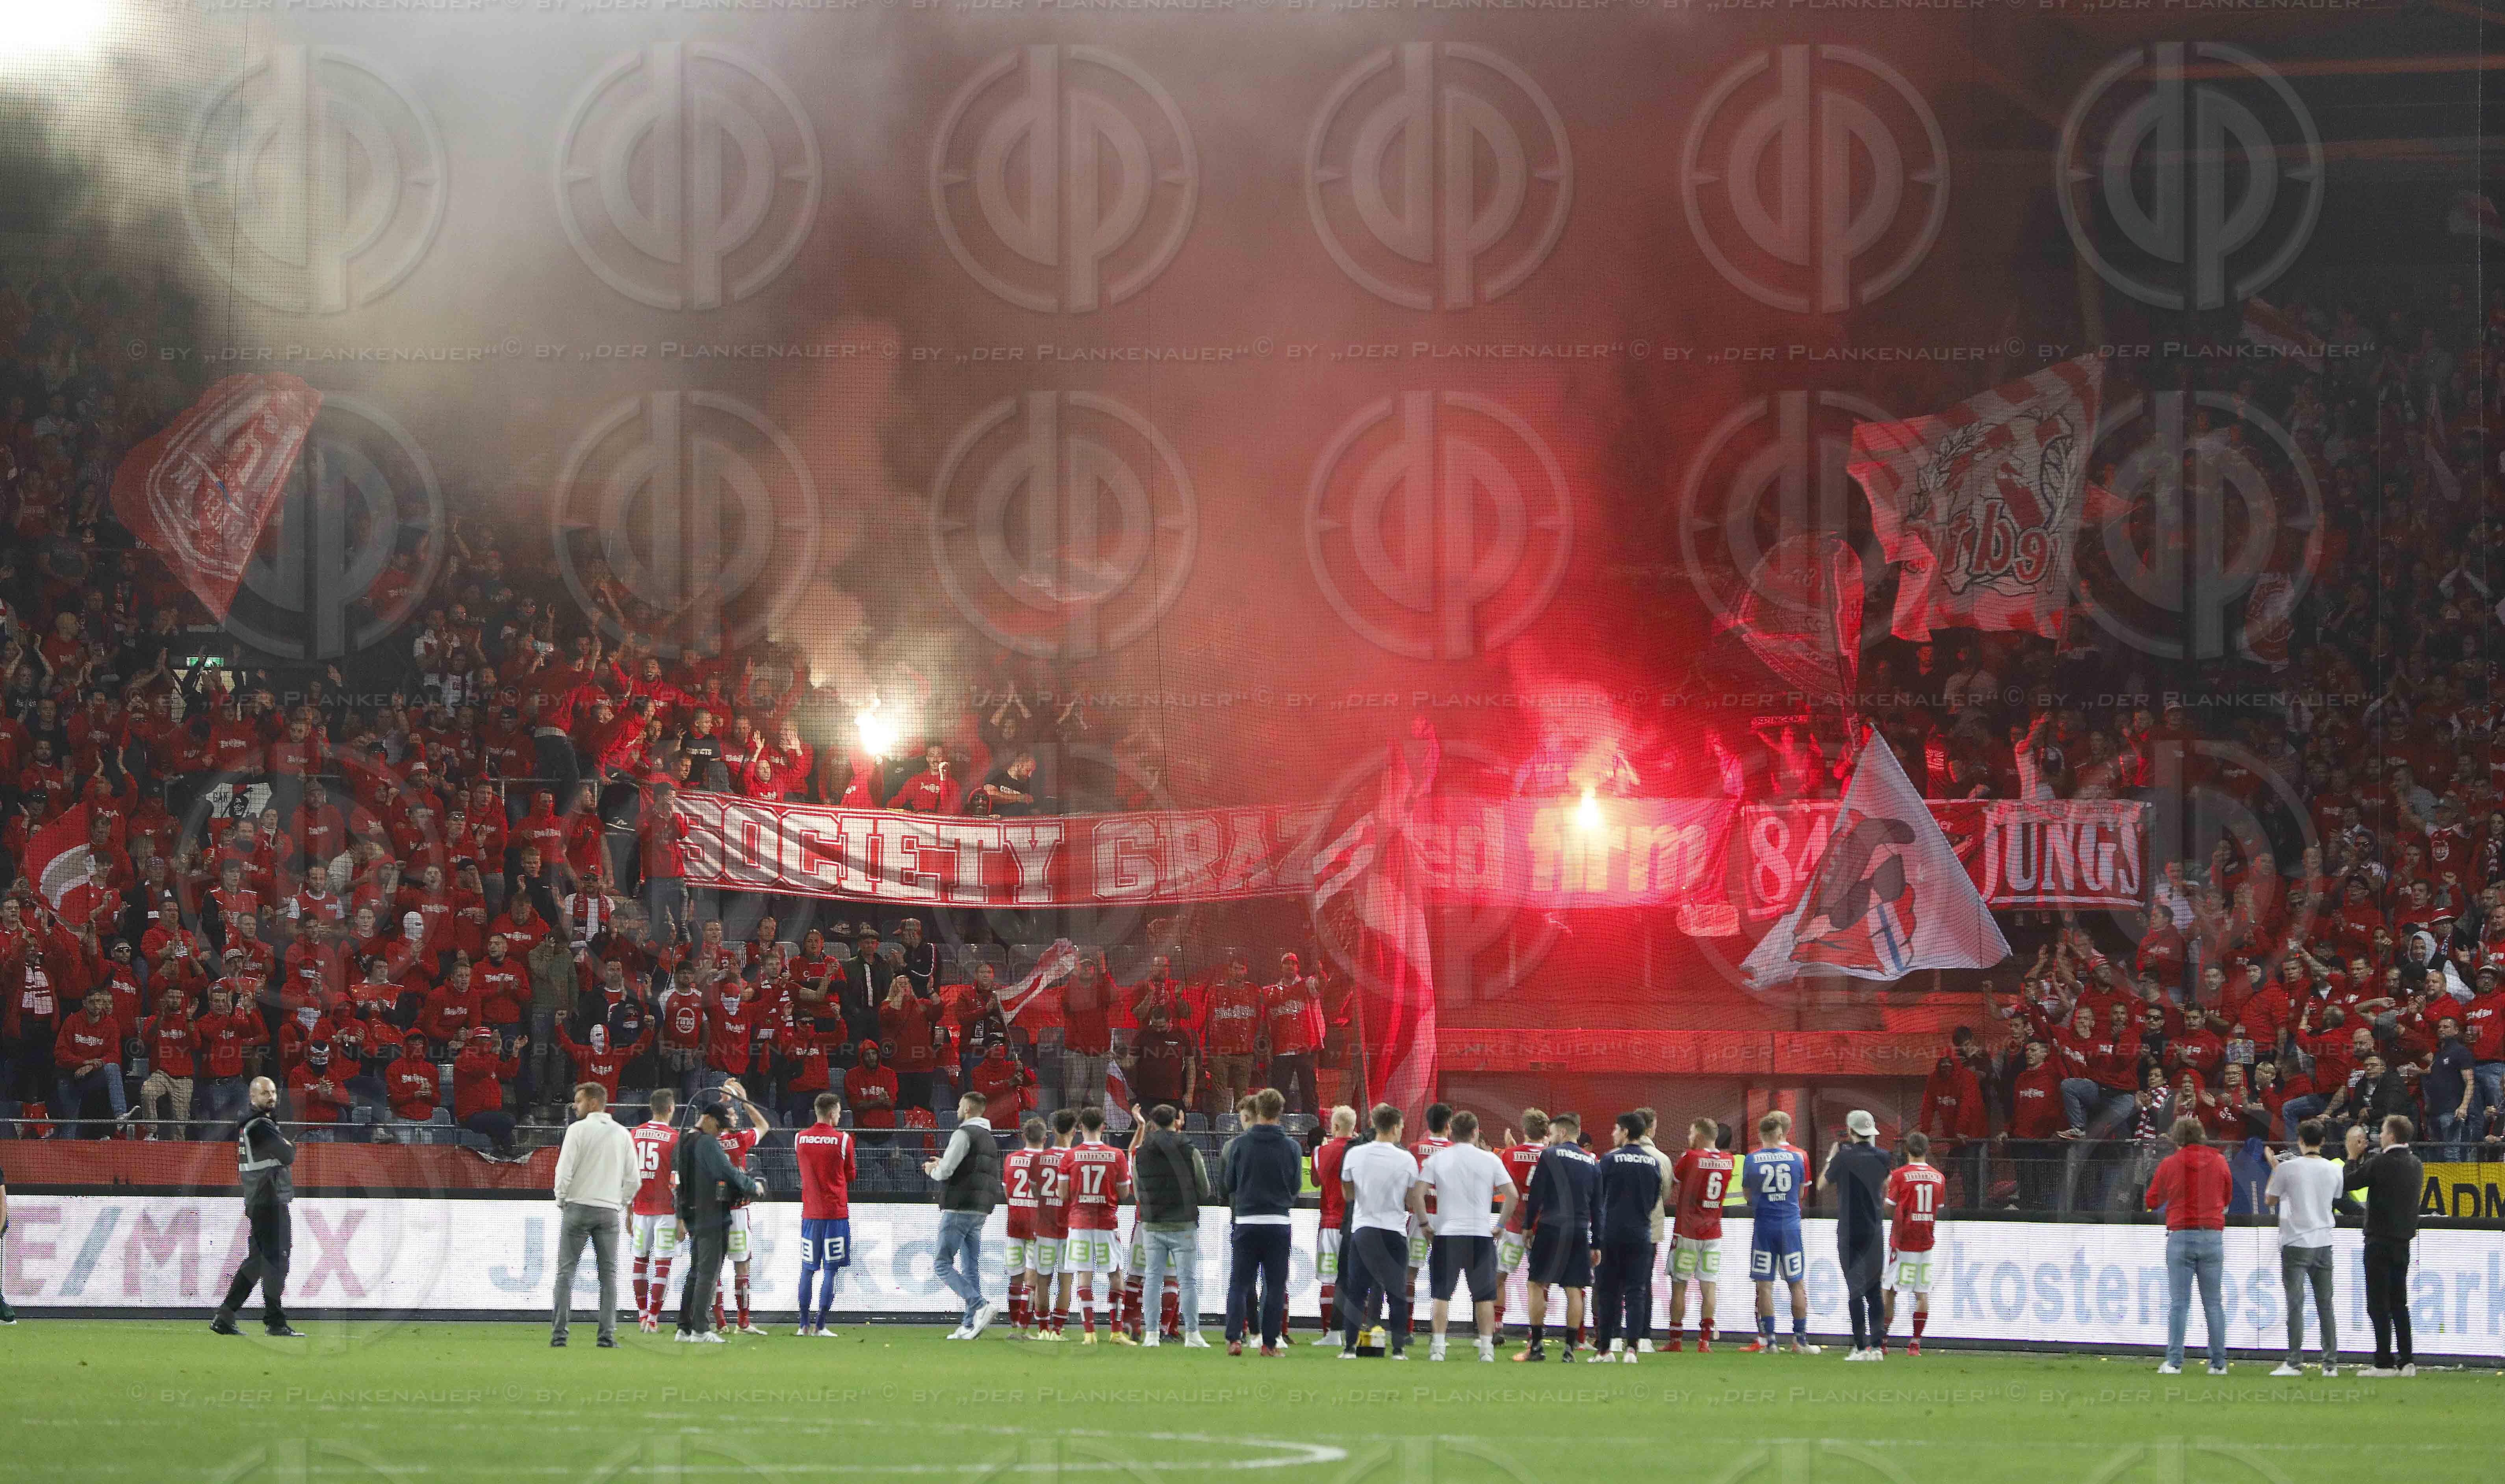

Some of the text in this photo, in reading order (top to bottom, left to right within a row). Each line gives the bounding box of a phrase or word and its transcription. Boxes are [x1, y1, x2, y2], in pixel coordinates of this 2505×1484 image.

[673, 794, 1065, 904] SOCIETY
[799, 1135, 838, 1145] macron
[636, 1141, 660, 1171] 15
[1556, 1147, 1595, 1166] macron
[1614, 1153, 1656, 1166] macron
[1080, 1164, 1106, 1194] 17
[1706, 1171, 1723, 1200] 6
[1760, 1163, 1792, 1193] 26
[1915, 1184, 1933, 1212] 11
